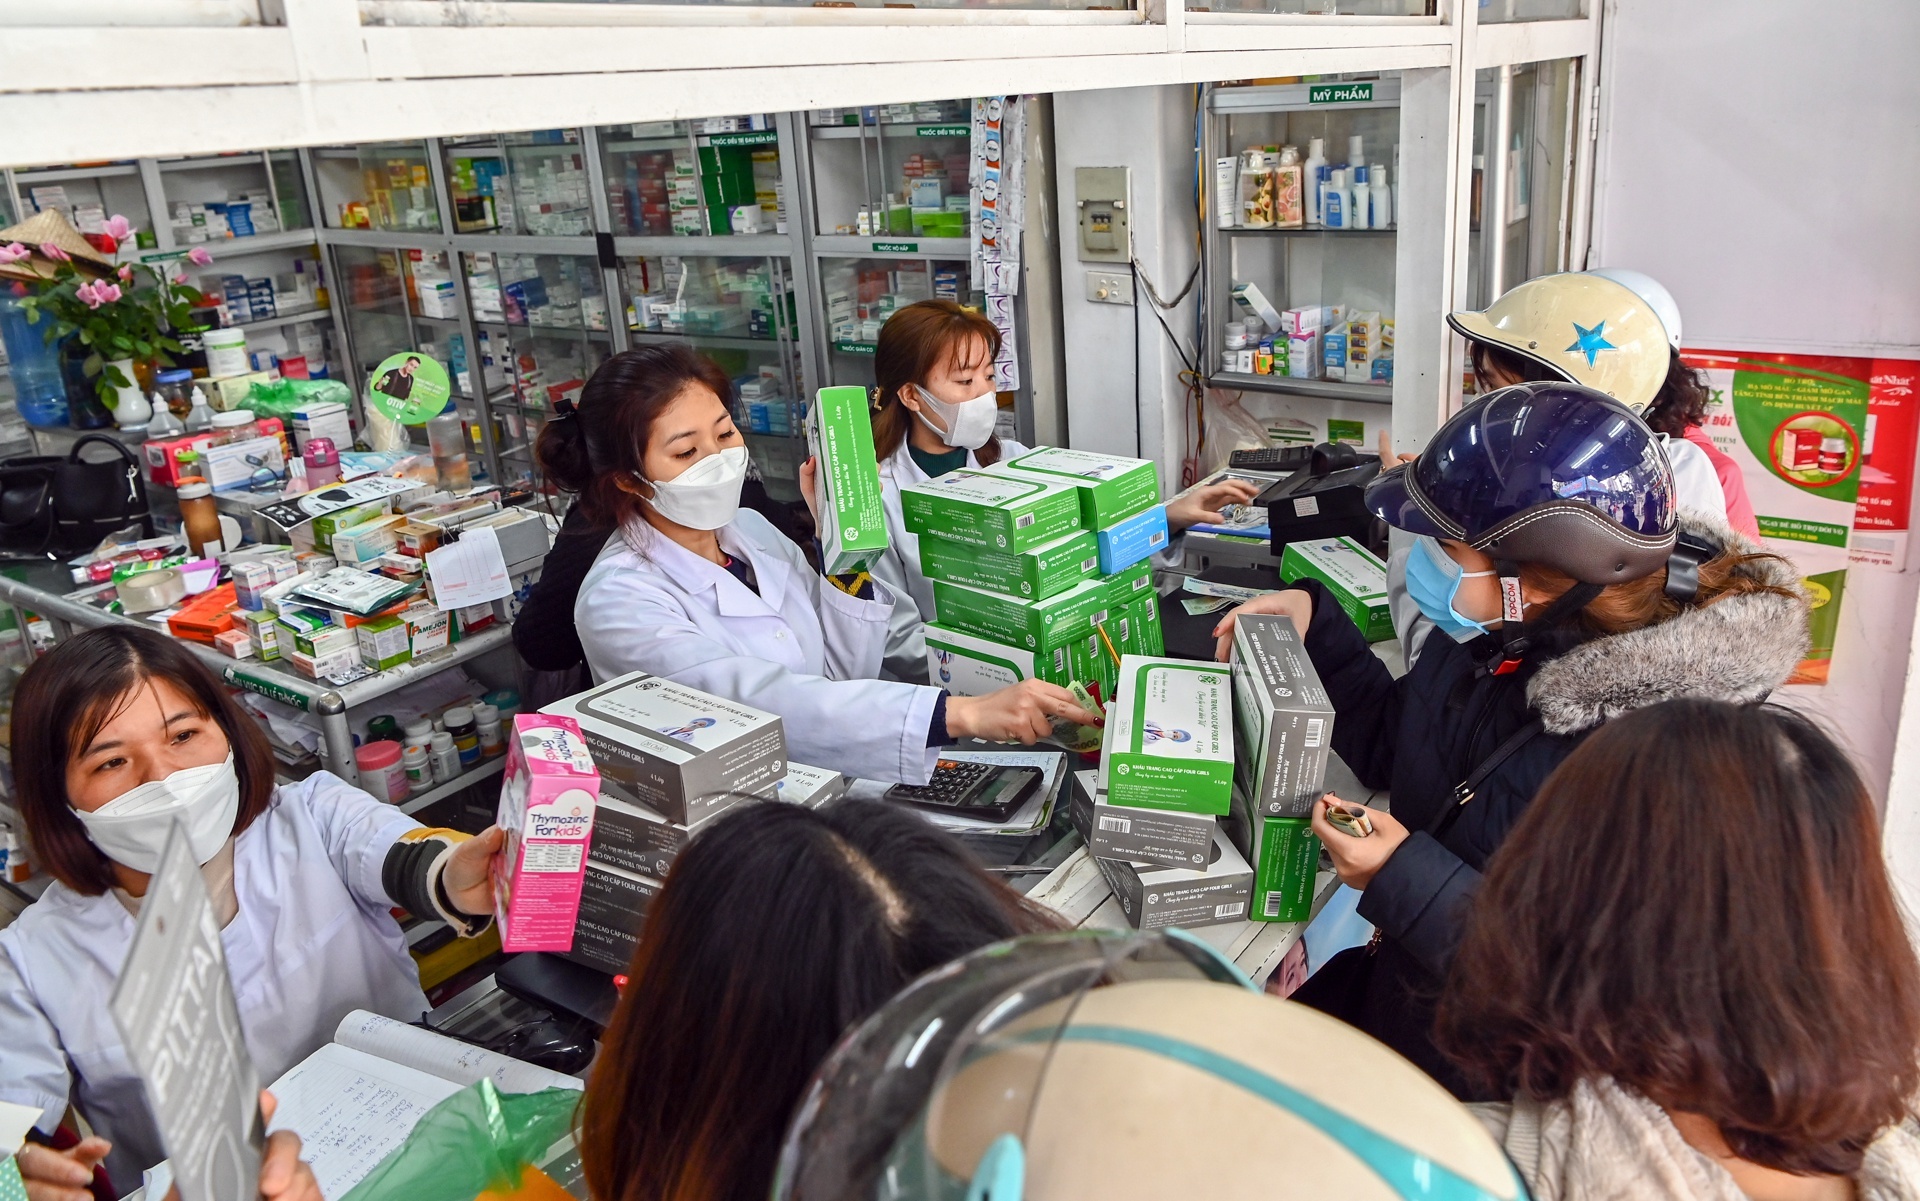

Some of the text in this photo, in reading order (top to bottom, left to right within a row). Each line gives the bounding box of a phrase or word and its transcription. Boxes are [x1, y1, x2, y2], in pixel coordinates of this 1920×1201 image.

[1314, 86, 1370, 101] MỸ PHẨM
[1508, 583, 1518, 619] TOPCOM
[412, 620, 447, 636] PAMEJON
[597, 740, 607, 750] CAO
[618, 748, 630, 758] FOUR
[631, 754, 645, 764] GIRLS
[654, 774, 665, 784] Lớp
[530, 813, 588, 827] Thymozinc
[535, 823, 582, 836] Forkids
[604, 852, 635, 868] TRANG CAO
[584, 870, 595, 878] ANG
[597, 873, 608, 882] CAO
[621, 881, 635, 891] FOUR
[637, 885, 652, 896] GIRLS
[580, 919, 597, 930] TRANG
[598, 923, 609, 934] CAO
[622, 932, 636, 943] FOUR
[152, 945, 212, 1103] PITTA
